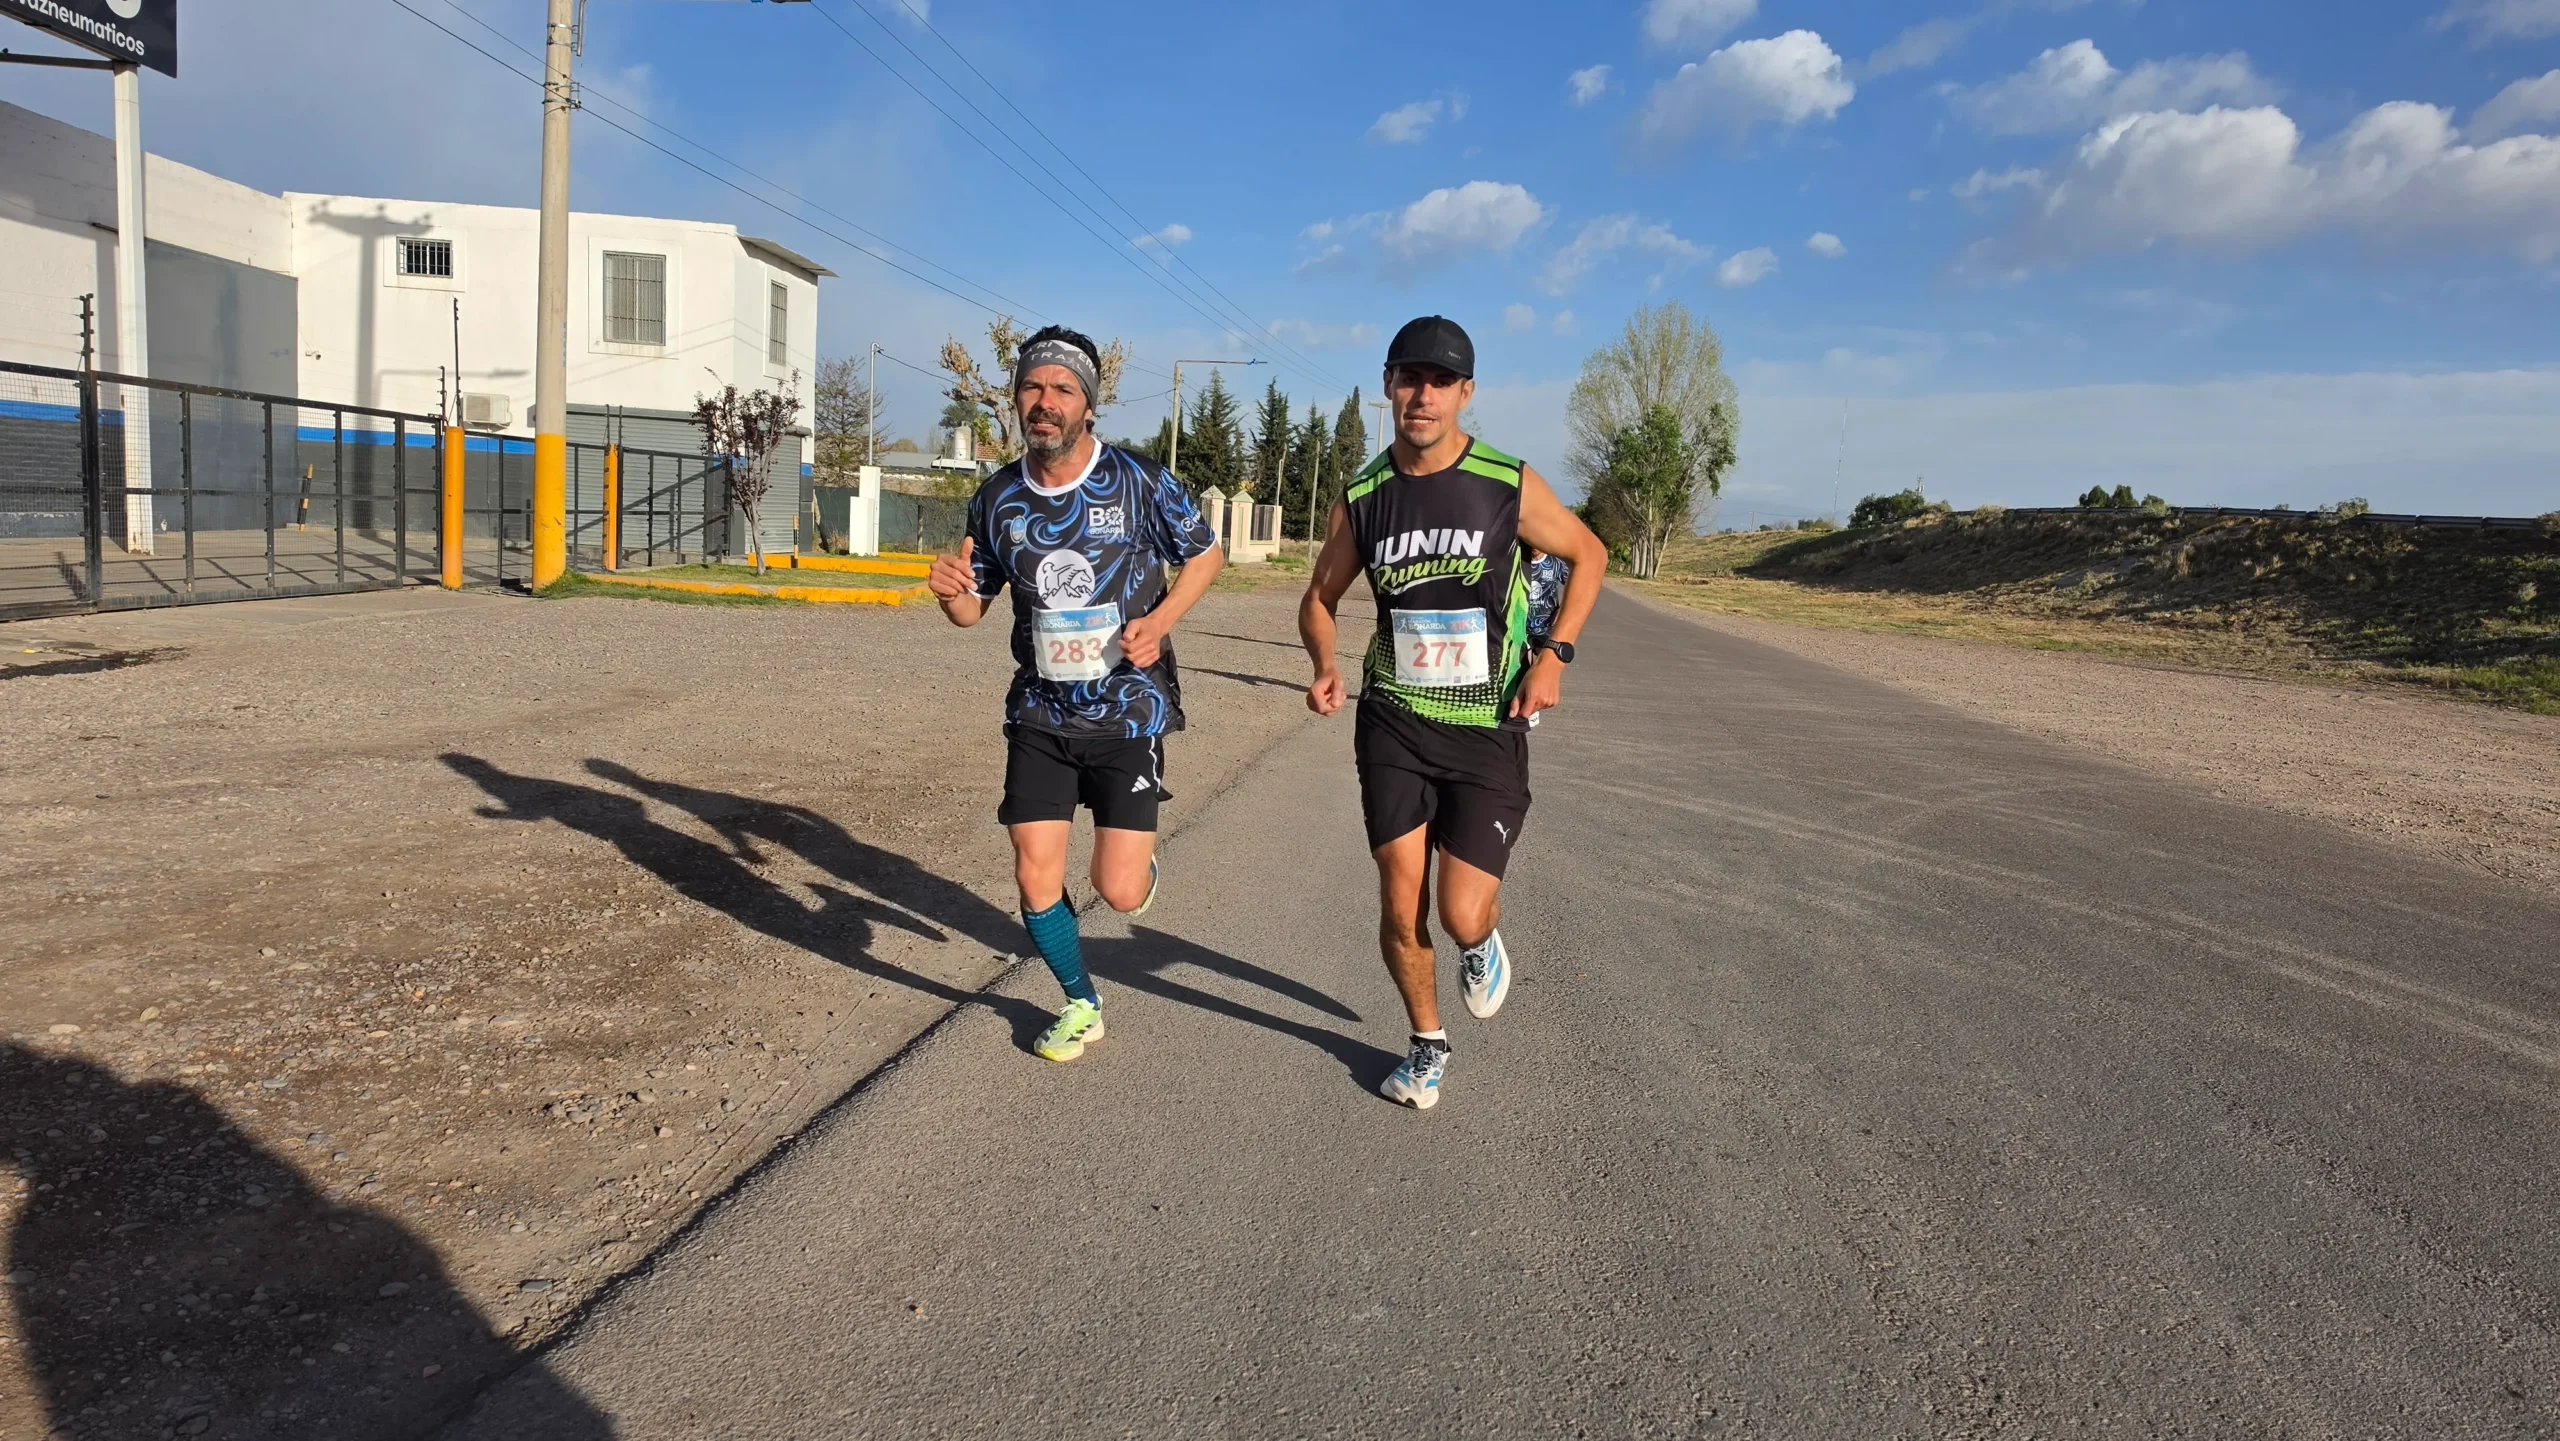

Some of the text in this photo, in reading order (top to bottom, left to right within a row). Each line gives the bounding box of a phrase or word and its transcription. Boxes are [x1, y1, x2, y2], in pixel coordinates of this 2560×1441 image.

[10, 0, 145, 56] azneumaticos
[1370, 528, 1485, 569] JUNIN
[1374, 552, 1487, 594] Running
[1043, 620, 1081, 629] BONARDA
[1048, 637, 1103, 664] 283
[1413, 641, 1466, 667] 277
